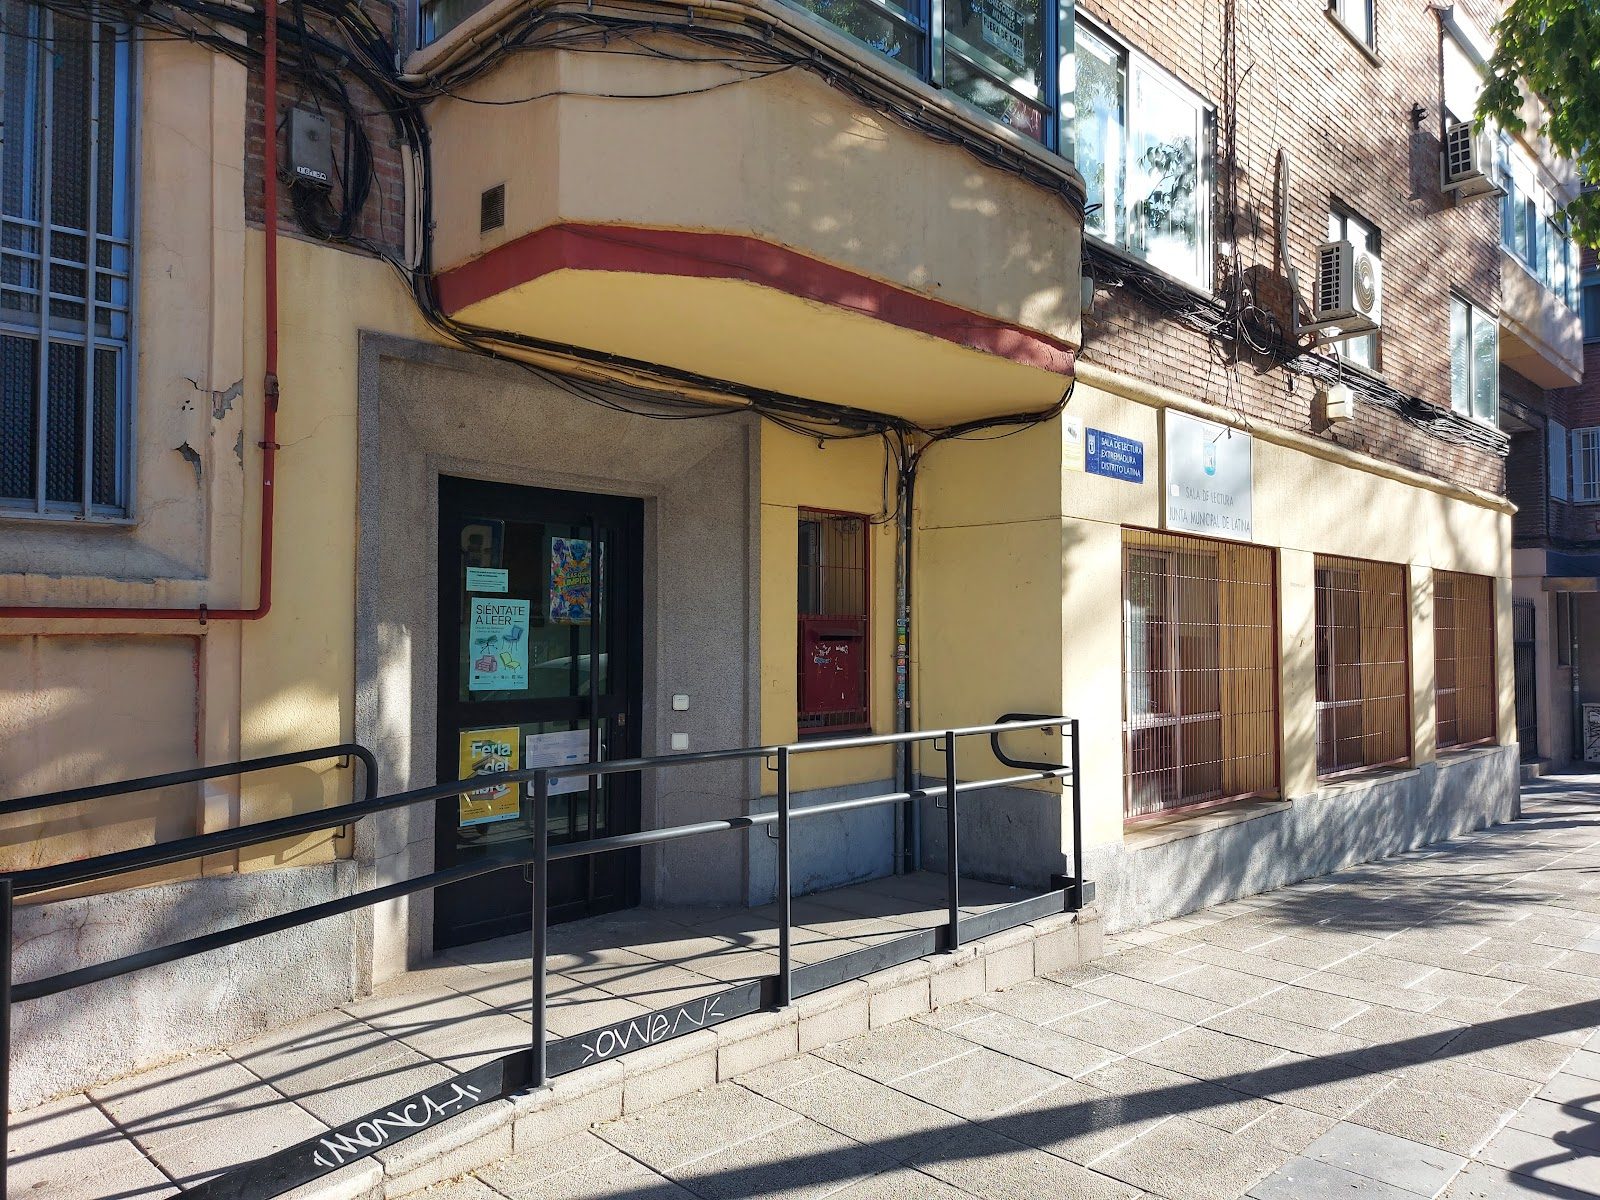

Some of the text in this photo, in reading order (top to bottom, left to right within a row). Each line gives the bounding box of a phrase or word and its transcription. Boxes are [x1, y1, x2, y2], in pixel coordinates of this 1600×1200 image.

[1101, 437, 1142, 455] SALA DE LECTURA
[1101, 449, 1137, 465] EXTREMADURA
[1101, 461, 1141, 478] DISTRITO LATINA
[1185, 486, 1234, 507] SALA DE LECTURA
[1169, 506, 1188, 523] JUNTA
[1222, 515, 1230, 530] DE
[1231, 517, 1250, 532] LATINA
[476, 603, 525, 616] SIÉNTATE
[475, 615, 512, 626] A LEER
[471, 740, 511, 759] Feria
